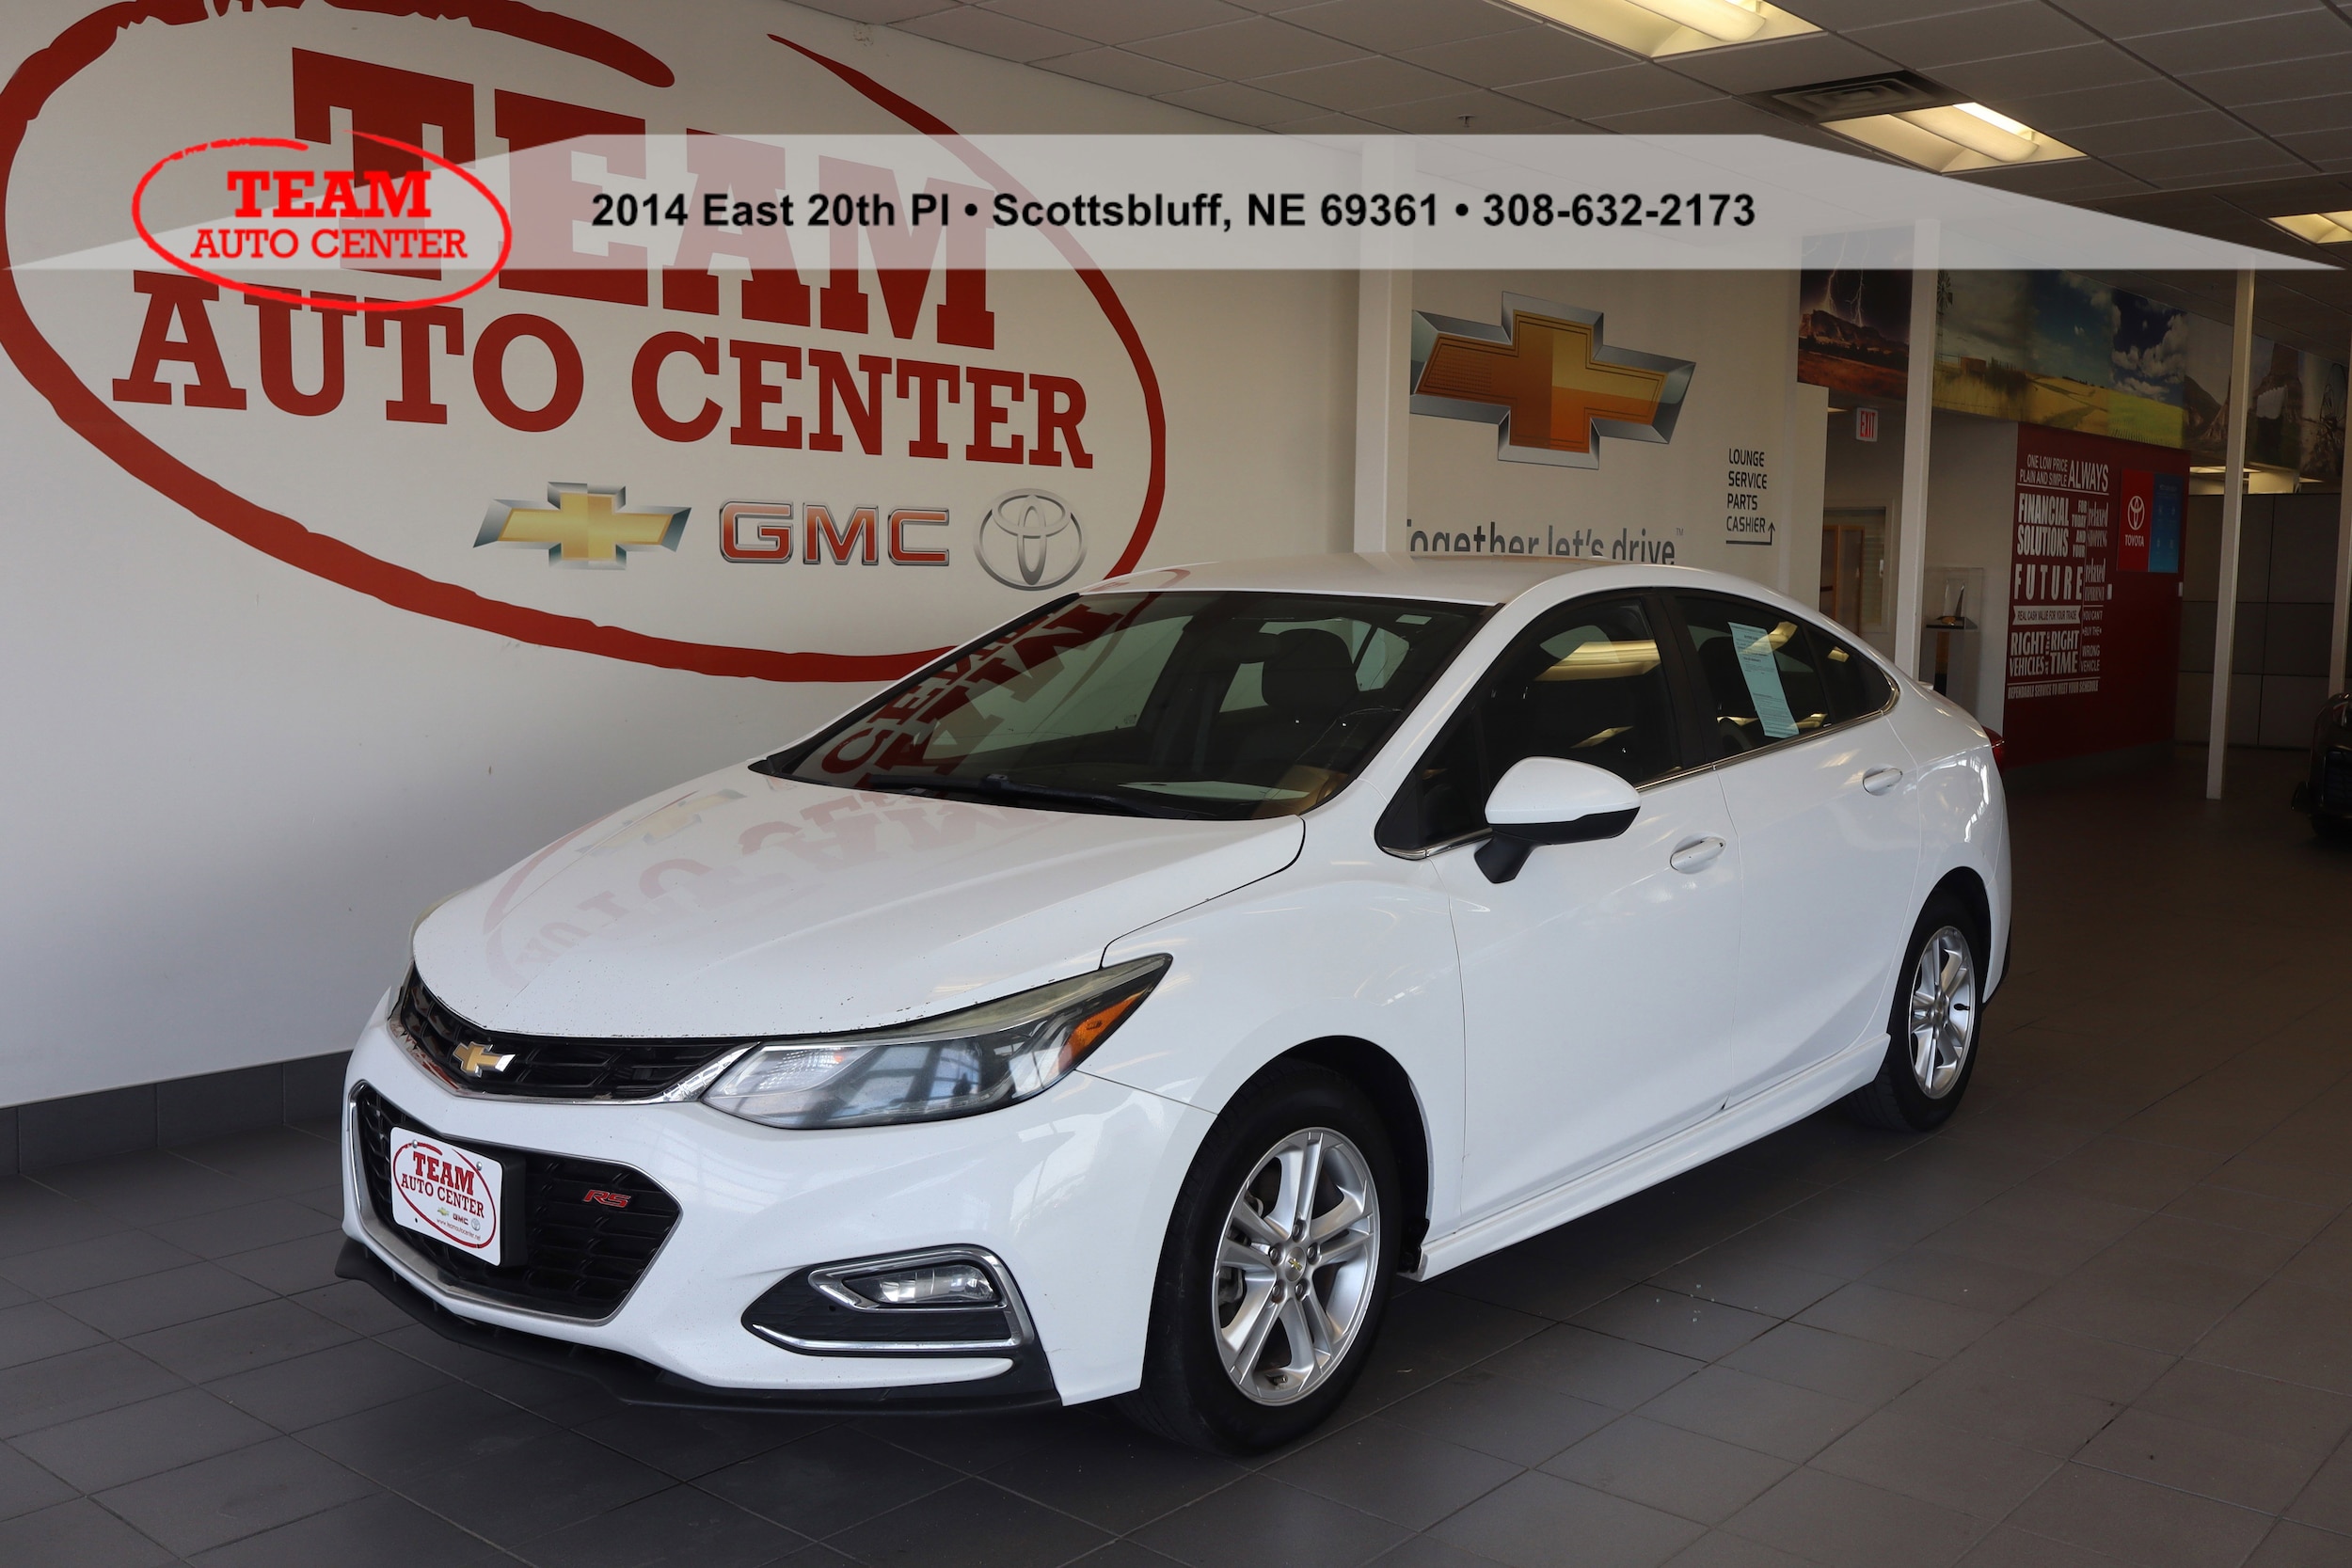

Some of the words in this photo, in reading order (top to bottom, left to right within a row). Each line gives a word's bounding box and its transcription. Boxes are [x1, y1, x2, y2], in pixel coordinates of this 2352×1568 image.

[292, 47, 995, 350] TEAM
[112, 270, 584, 433] AUTO
[631, 330, 1093, 469] CENTER
[1860, 410, 1876, 439] EXIT
[1728, 448, 1765, 467] LOUNGE
[2026, 453, 2039, 468] ONE
[2039, 455, 2053, 470] LOW
[2052, 457, 2068, 472] PRICE
[1728, 470, 1768, 489] SERVICE
[2019, 468, 2036, 483] PLAIN
[2036, 470, 2048, 485] AND
[2048, 472, 2068, 487] SIMPLE
[2067, 459, 2109, 492] ALWAYS
[1726, 493, 1758, 511] PARTS
[2018, 492, 2070, 526] FINANCIAL
[2077, 499, 2088, 514] FOR
[719, 499, 950, 566] GMC
[1726, 515, 1766, 533] CASHIER
[1407, 519, 1539, 555] ogether
[1612, 527, 1676, 564] drive
[2016, 524, 2070, 558] SOLUTIONS
[2124, 534, 2145, 547] TOYOTA
[2013, 562, 2084, 601] FUTURE
[2010, 631, 2046, 657] RIGHT
[2051, 629, 2080, 651] RIGHT
[2082, 644, 2100, 657] WRONG
[2009, 656, 2045, 677] VEHICLES
[2050, 651, 2078, 675] TIME
[2080, 659, 2100, 673] VEHICLE
[412, 1150, 475, 1196] TEAM
[401, 1173, 435, 1197] AUTO
[437, 1182, 485, 1219] CENTER
[581, 1189, 631, 1209] RS
[453, 1212, 469, 1227] GMC
